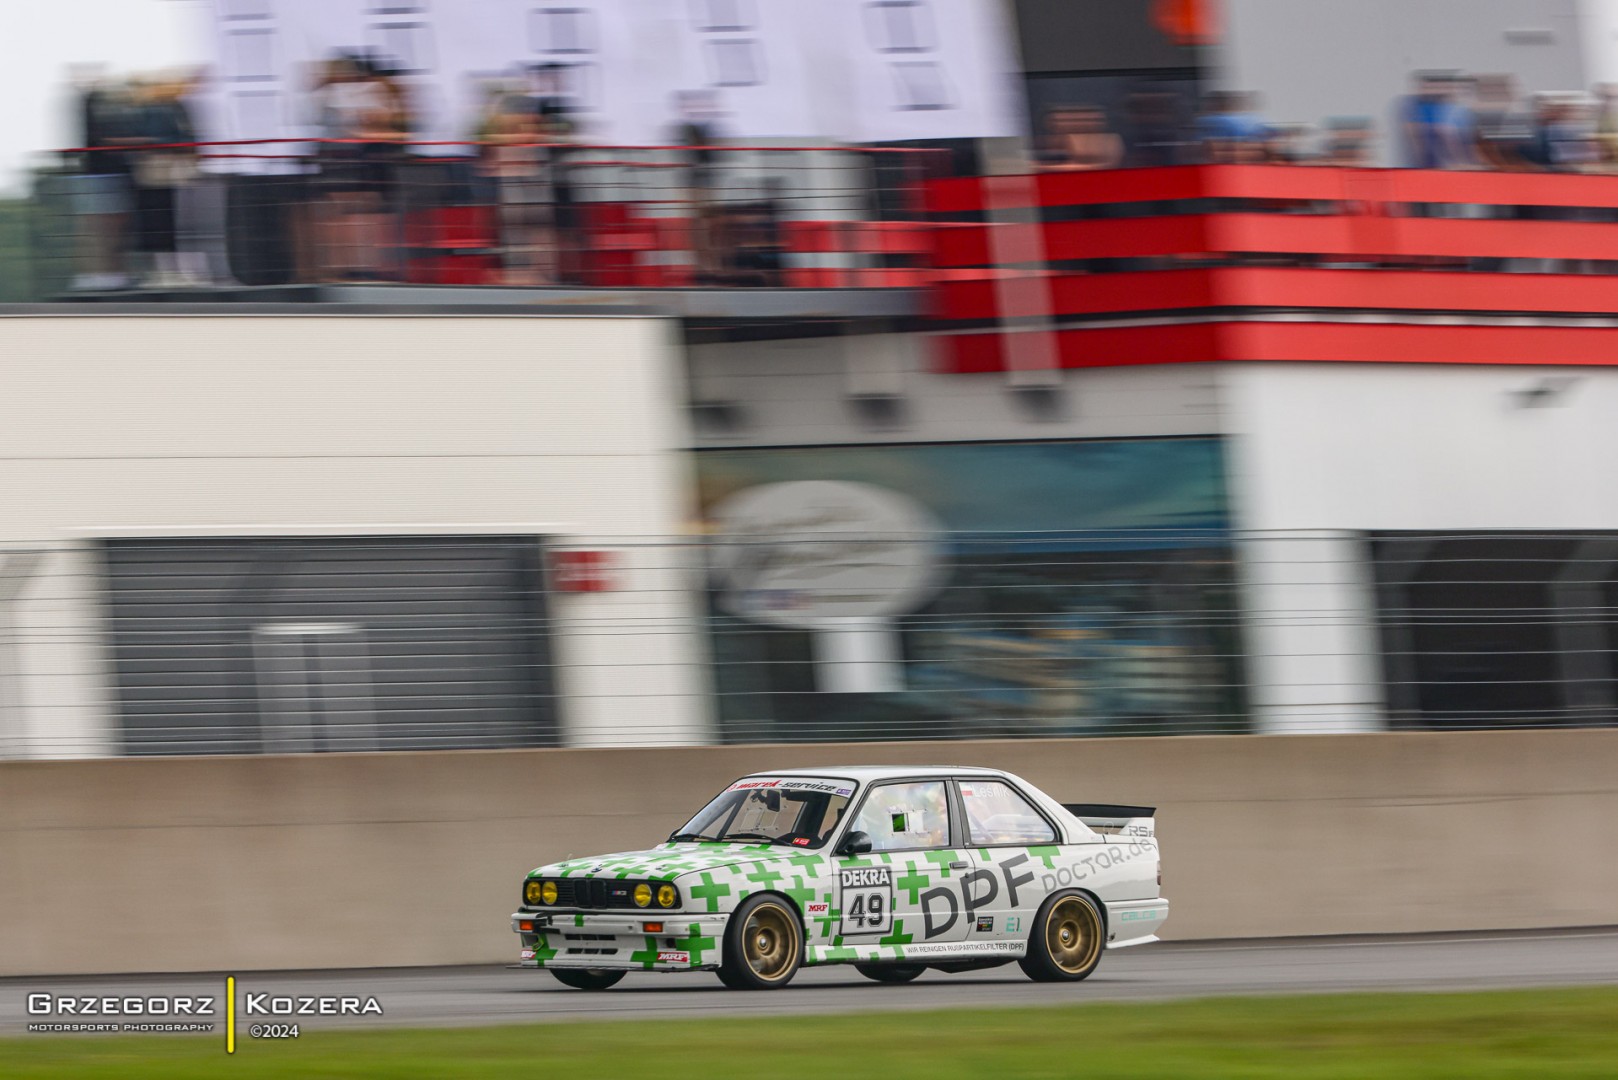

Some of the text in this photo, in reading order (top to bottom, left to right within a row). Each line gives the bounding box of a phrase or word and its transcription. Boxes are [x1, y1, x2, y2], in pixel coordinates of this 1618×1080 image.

[842, 868, 890, 887] DEKRA
[920, 853, 1035, 940] DPF
[808, 904, 828, 912] MRF
[848, 893, 884, 929] 49
[658, 952, 688, 960] MRF
